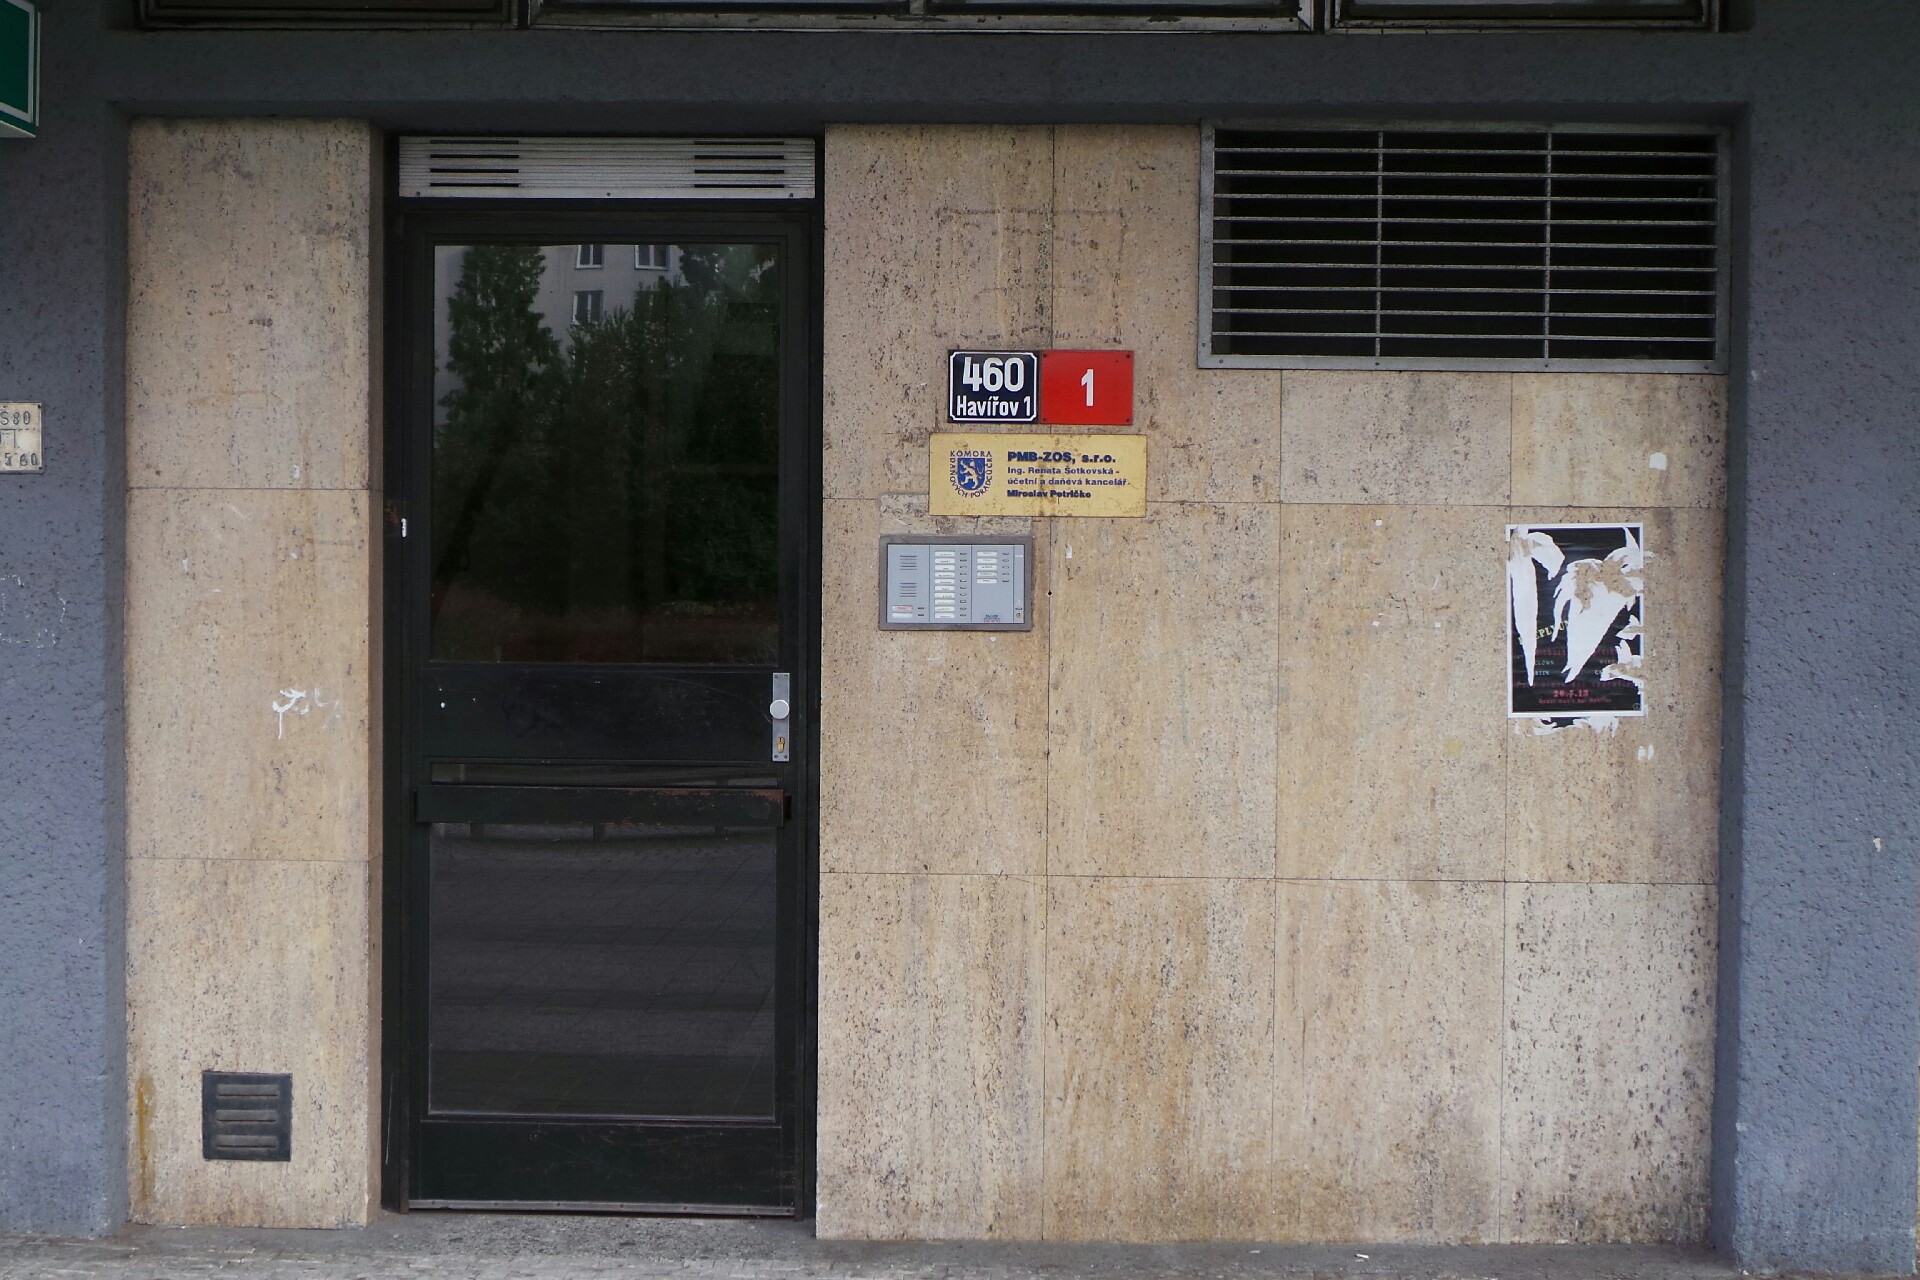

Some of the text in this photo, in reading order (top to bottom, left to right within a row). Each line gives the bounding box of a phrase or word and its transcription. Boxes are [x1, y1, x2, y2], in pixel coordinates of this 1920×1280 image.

[962, 356, 1025, 392] 460
[1081, 368, 1094, 407] 1
[956, 395, 1031, 416] Havířov 1
[1007, 451, 1116, 464] PMB-ZOS, s.r.o.
[1007, 466, 1026, 475] Ing.
[1028, 466, 1062, 474] Renata
[1064, 465, 1114, 475] Šotkovská
[1007, 477, 1038, 485] účetní
[1048, 477, 1083, 486] daňová
[1007, 489, 1049, 498] Miroslav
